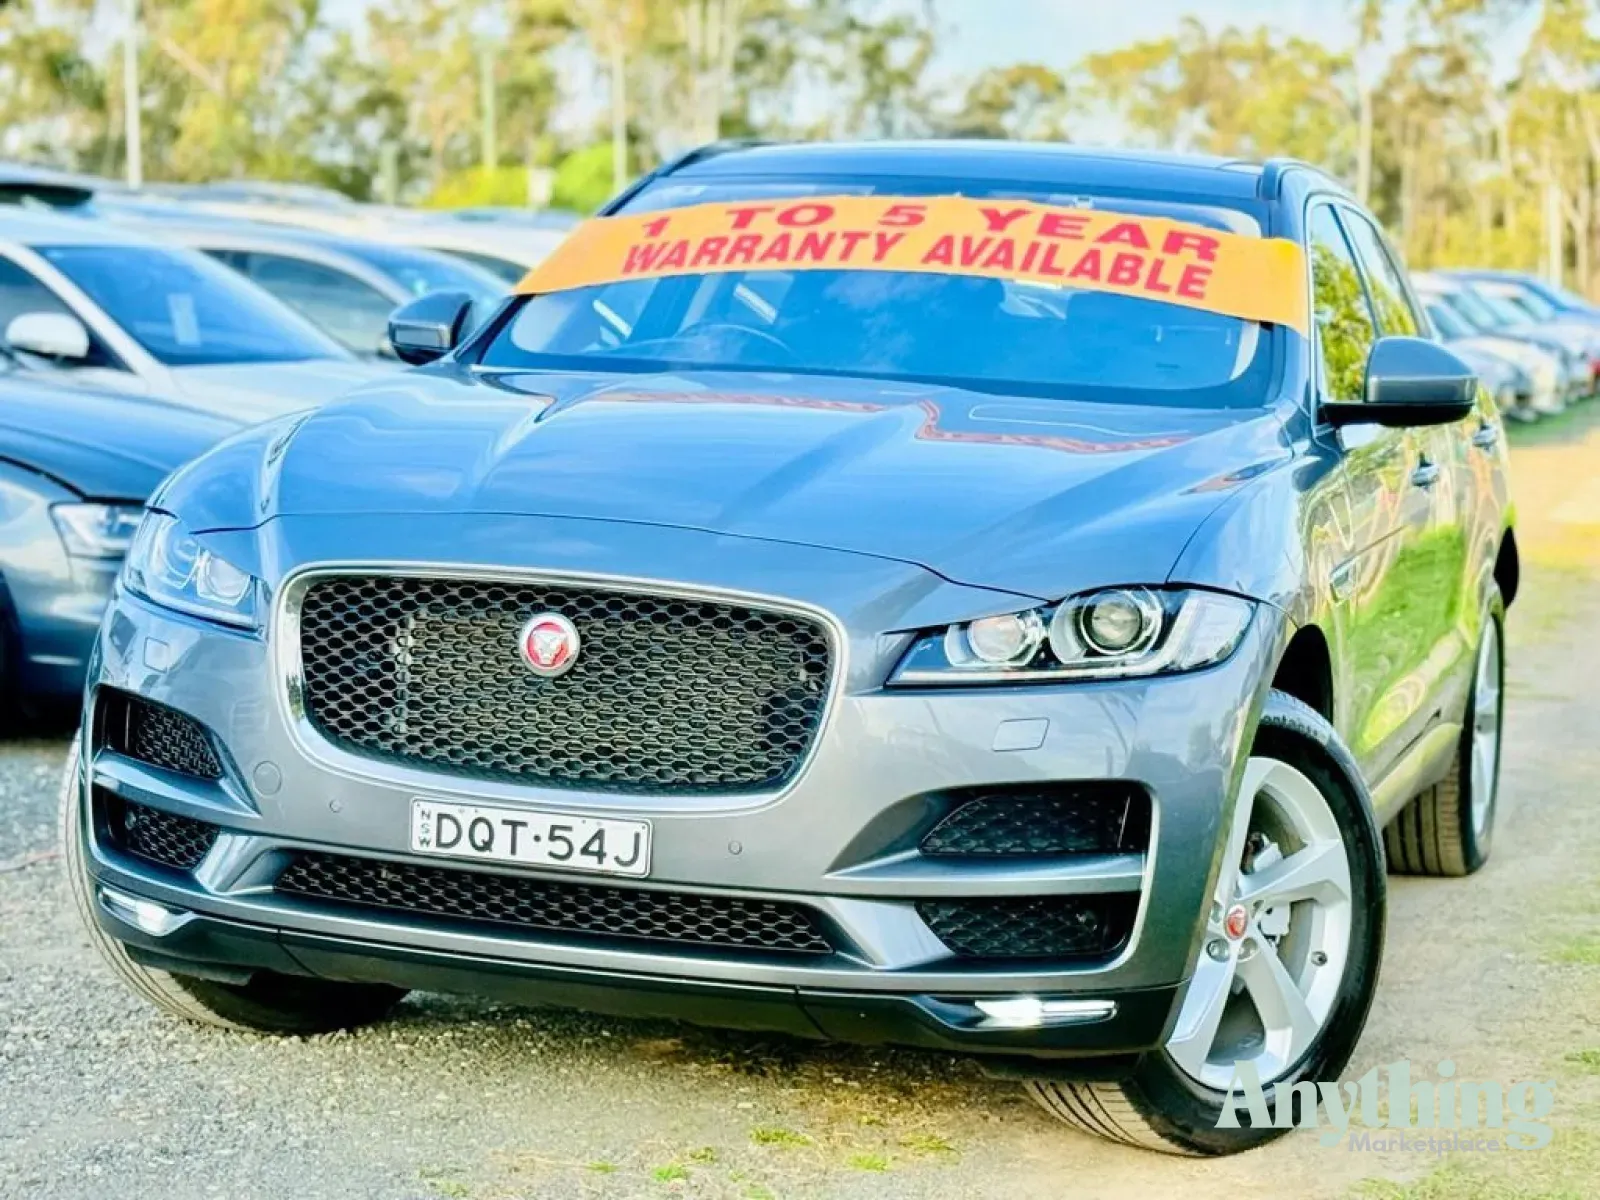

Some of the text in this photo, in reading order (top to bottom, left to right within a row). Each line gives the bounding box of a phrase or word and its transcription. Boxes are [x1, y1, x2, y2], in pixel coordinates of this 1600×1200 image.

[641, 204, 1221, 262] 1 TO 5 YEAR
[622, 231, 1213, 299] WARRANTY AVAILABLE
